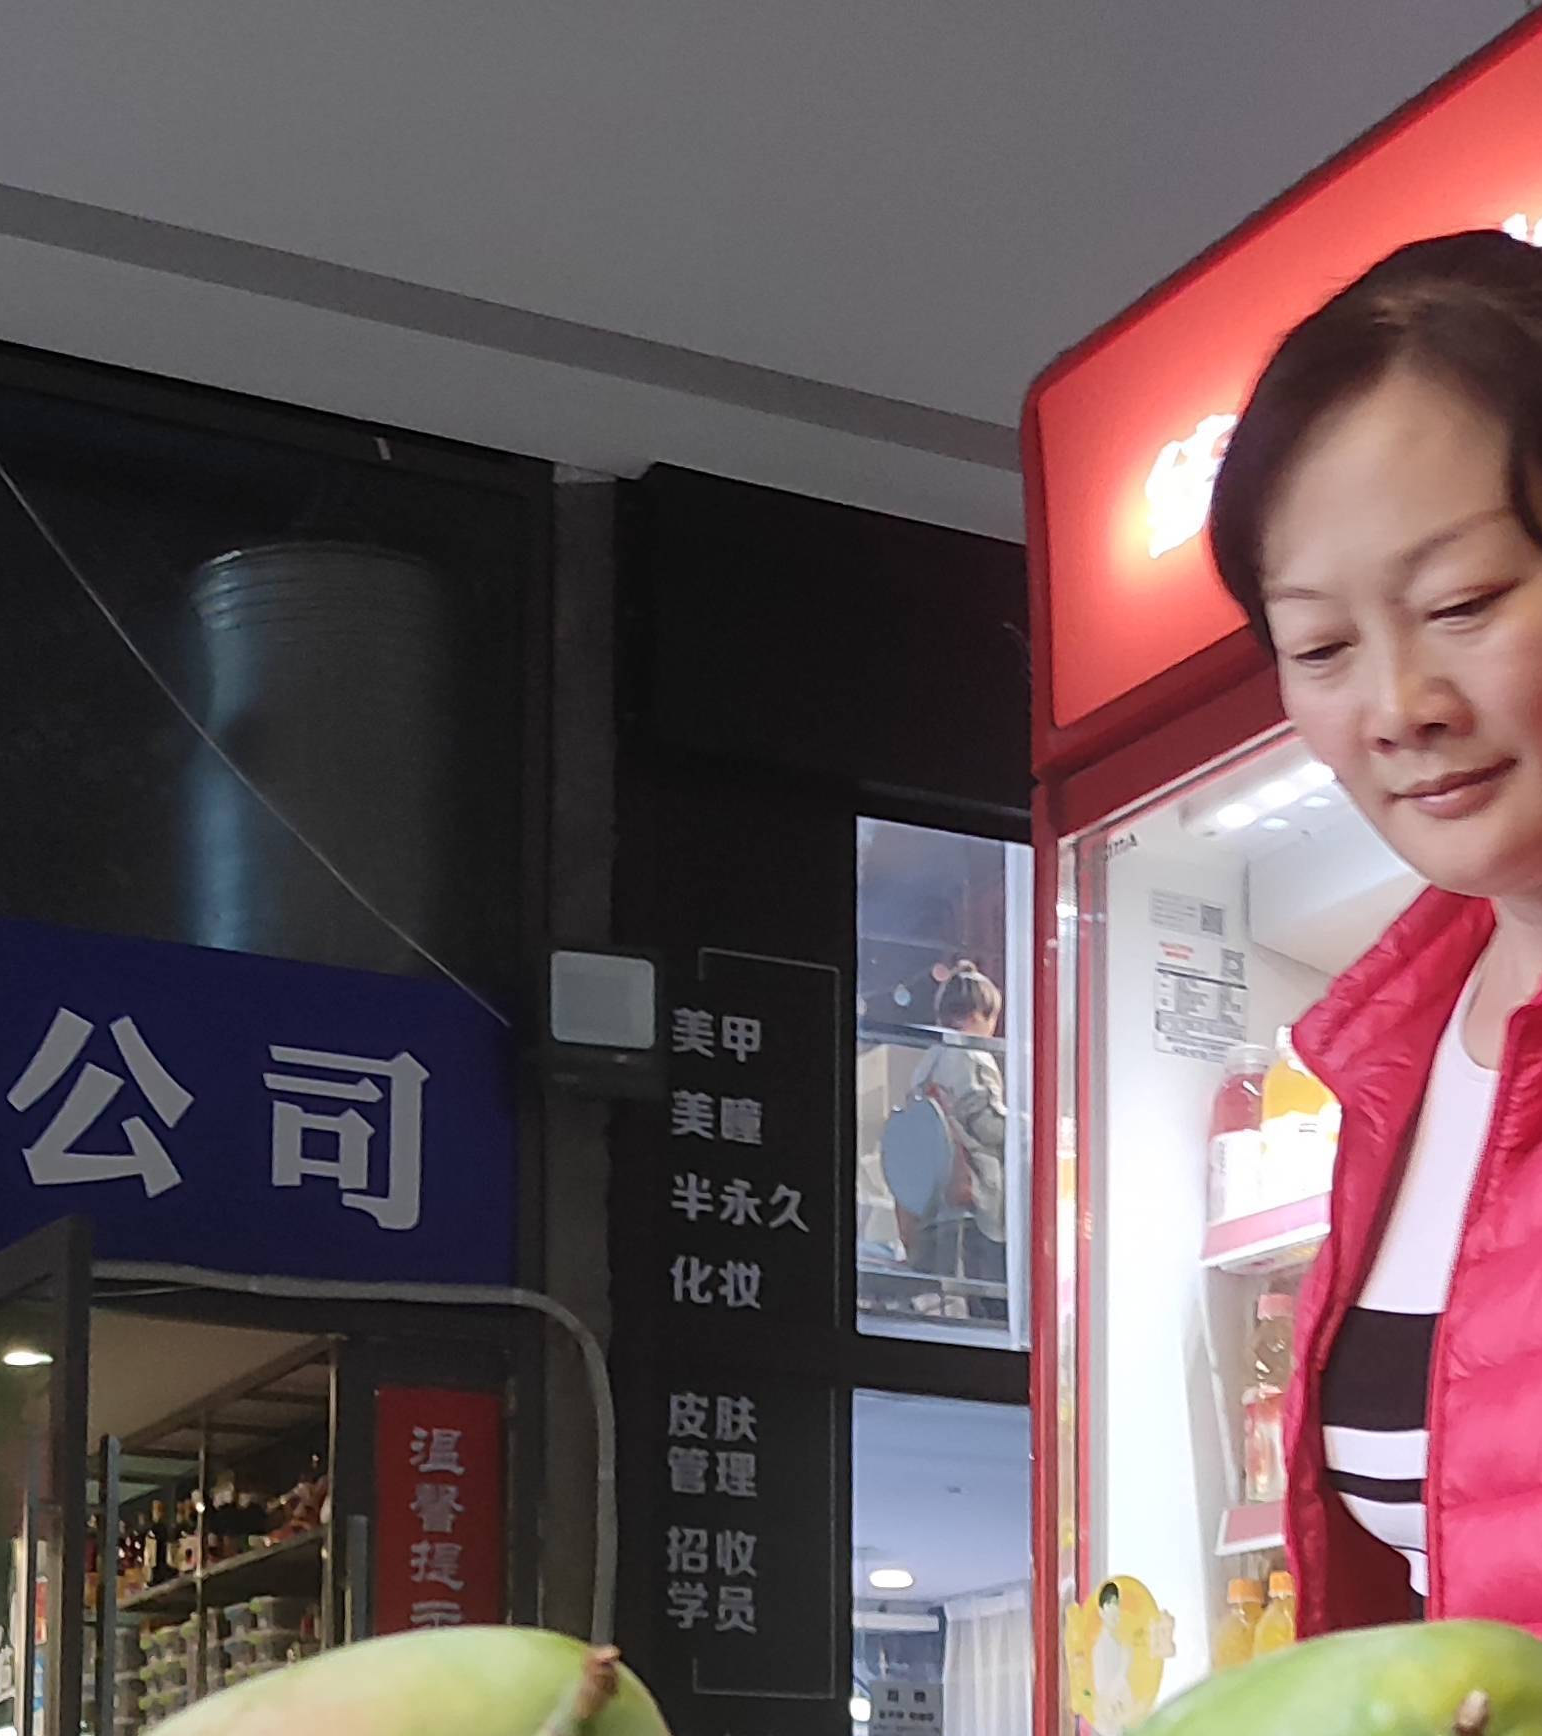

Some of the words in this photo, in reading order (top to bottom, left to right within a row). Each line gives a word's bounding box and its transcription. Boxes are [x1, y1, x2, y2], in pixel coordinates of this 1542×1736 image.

[670, 1008, 763, 1062] 美甲
[6, 1006, 431, 1231] 公司
[670, 1173, 810, 1233] 半永久
[670, 1255, 763, 1310] 化妆
[668, 1392, 758, 1443] 皮肤
[667, 1446, 758, 1499] 管理
[666, 1525, 757, 1577] 招收
[666, 1580, 757, 1635] 学员
